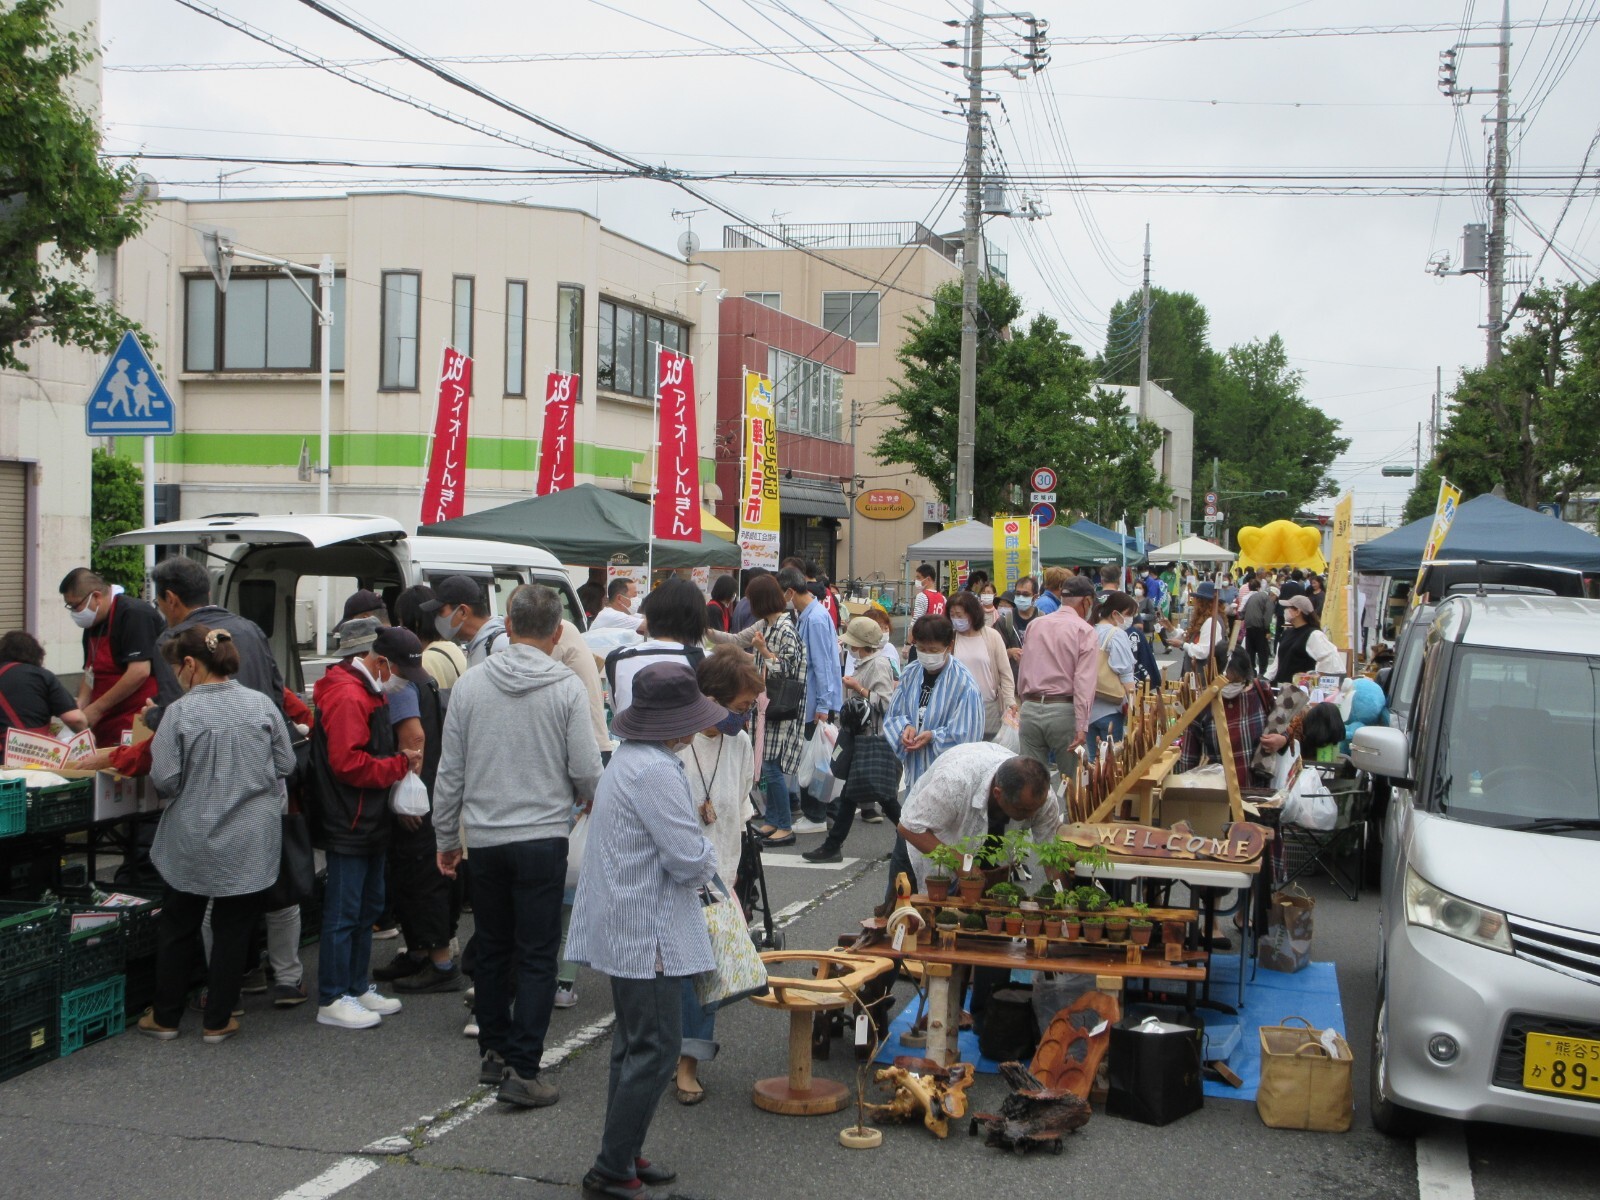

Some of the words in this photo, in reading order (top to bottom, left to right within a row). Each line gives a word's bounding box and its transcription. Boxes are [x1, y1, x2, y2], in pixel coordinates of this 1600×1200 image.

[437, 384, 465, 523] アイオーしんきん
[672, 388, 693, 536] アイオーしんきん
[745, 418, 763, 523] 軽トラ市
[1037, 474, 1051, 486] 30
[870, 494, 900, 502] たこやき
[1097, 827, 1250, 858] WELCOME
[1531, 1063, 1547, 1078] か
